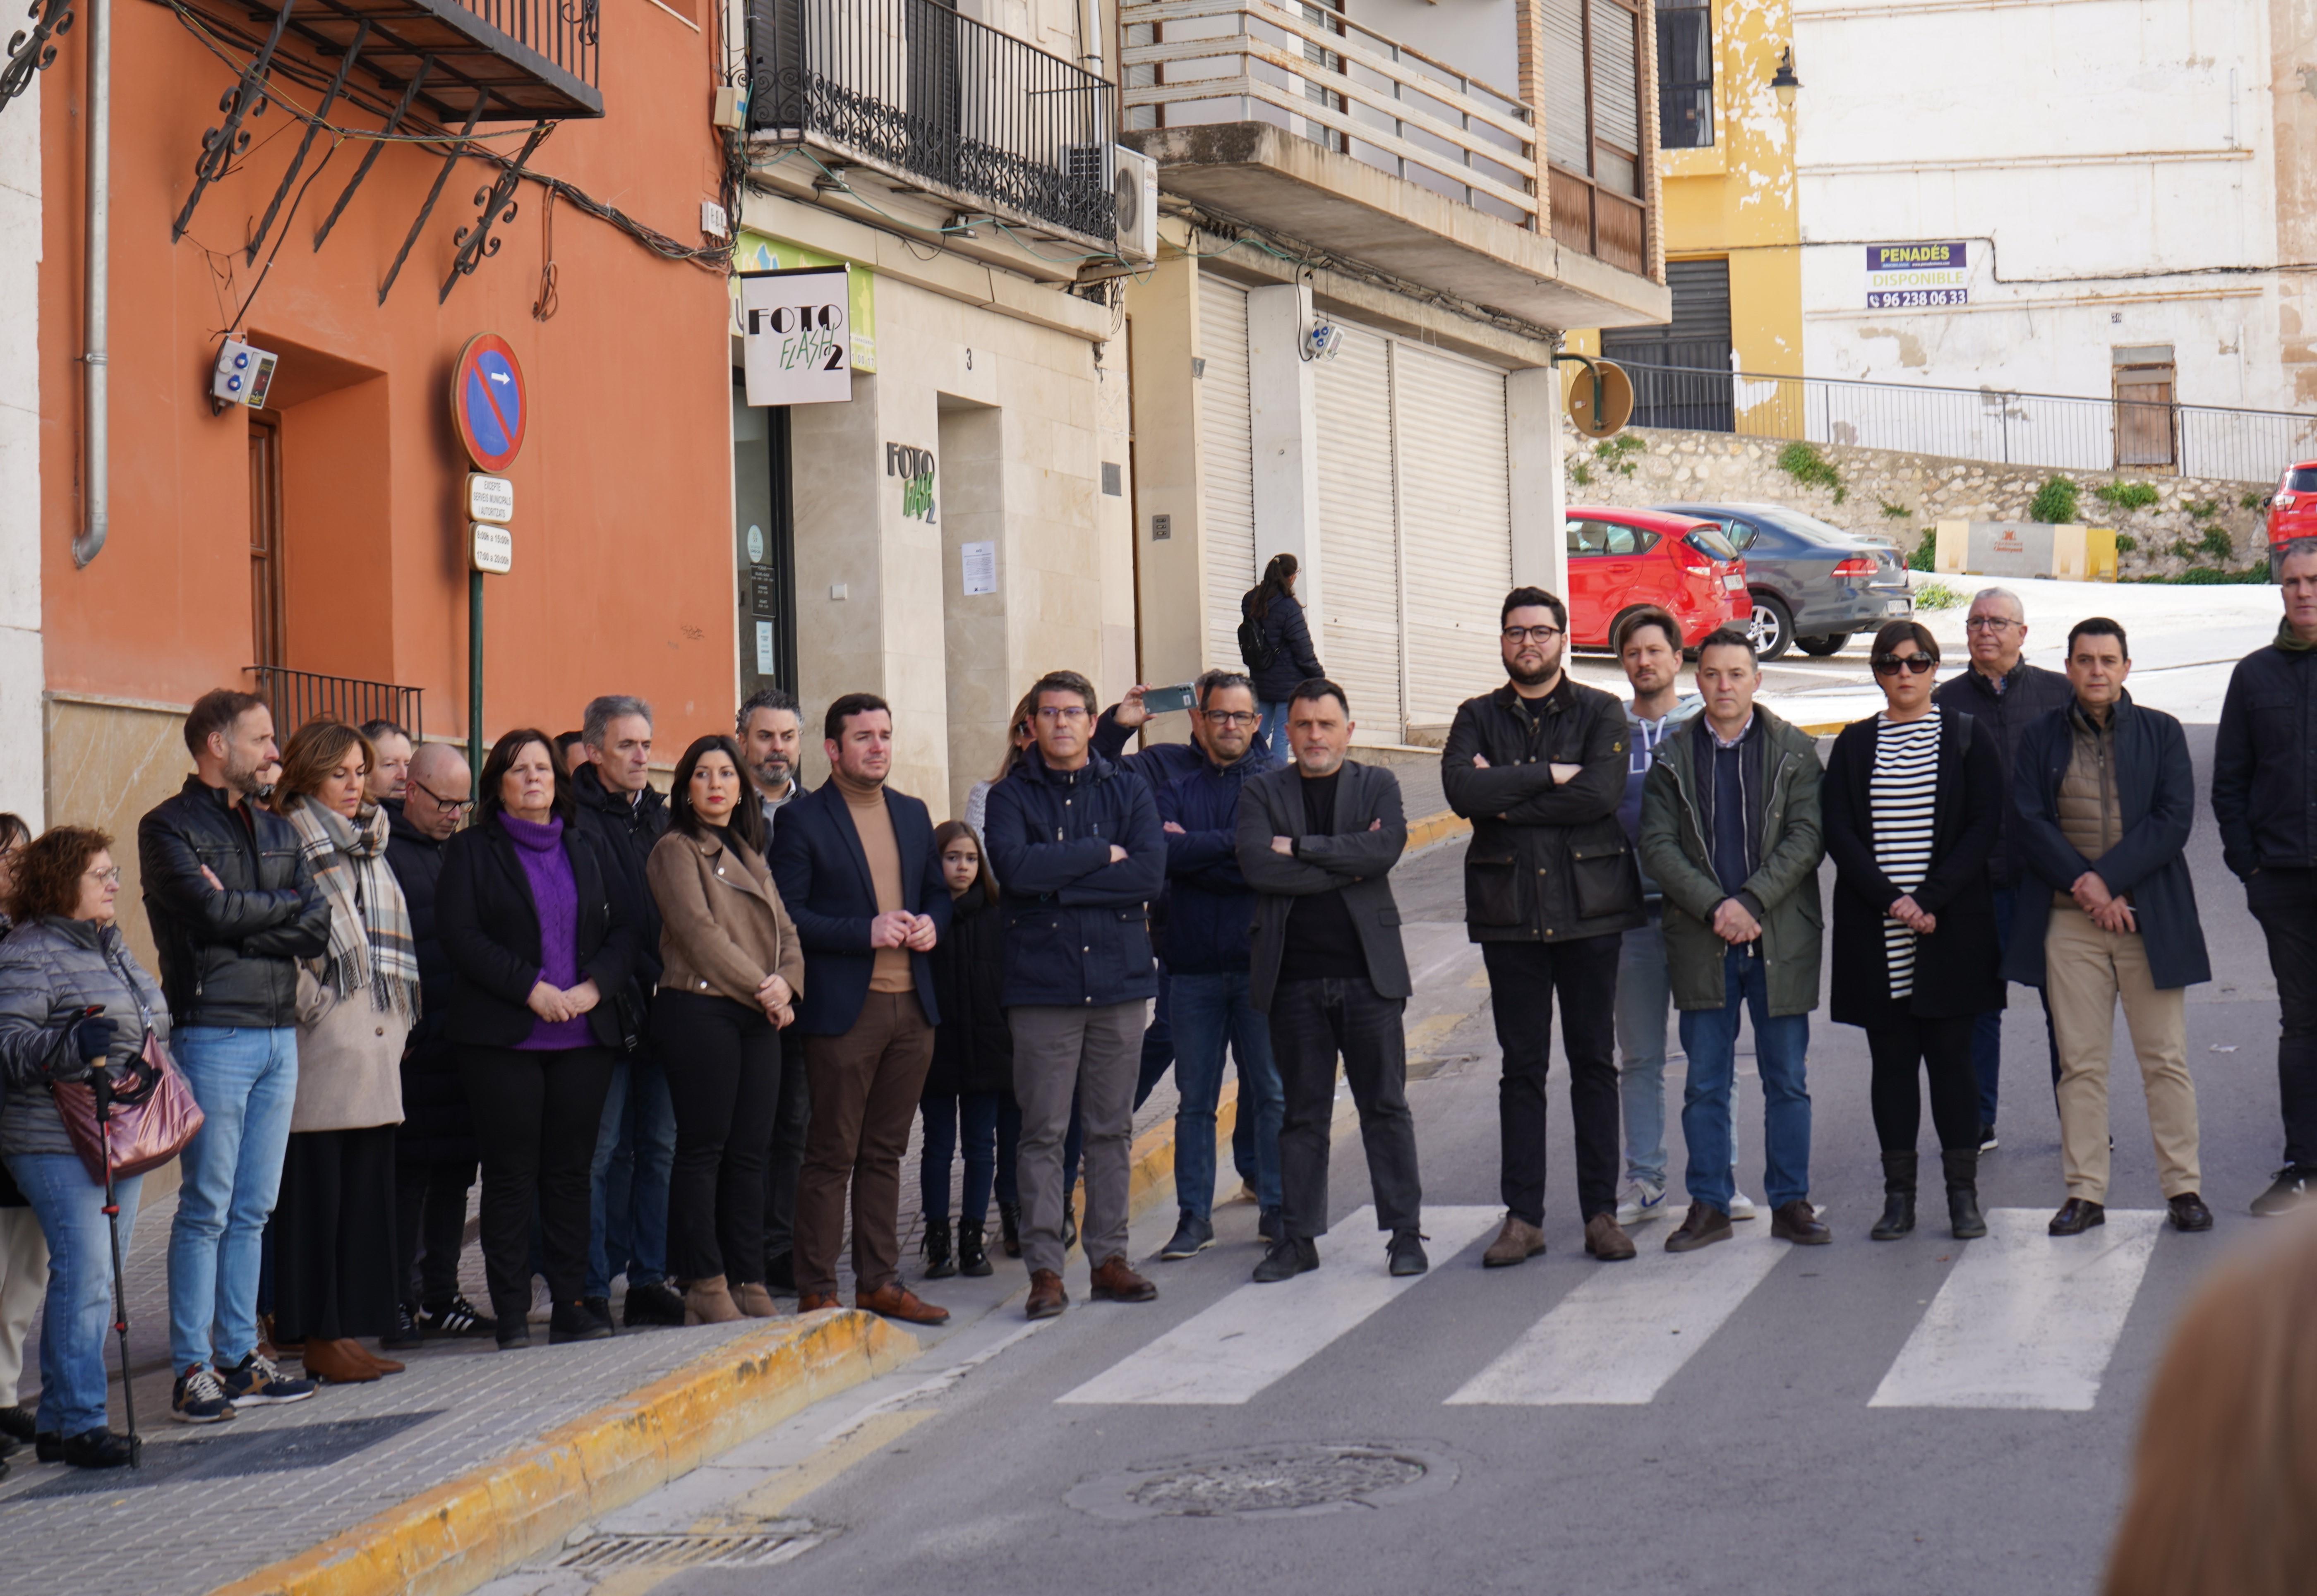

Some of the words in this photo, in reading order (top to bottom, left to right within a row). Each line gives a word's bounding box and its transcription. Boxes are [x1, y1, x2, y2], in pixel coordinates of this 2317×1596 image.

[1881, 244, 1950, 262] PENADÉS
[1873, 271, 1963, 286] DISPONIBLE
[1883, 292, 1900, 307] 96
[1903, 291, 1927, 306] 238
[1930, 290, 1947, 305] 06
[1950, 290, 1965, 304] 33
[748, 304, 842, 335] FOTO
[780, 323, 835, 370] FLASH
[824, 344, 843, 370] 2
[858, 354, 864, 364] 00
[868, 357, 874, 367] 17
[967, 347, 972, 370] 3
[887, 441, 935, 481] FOTO
[485, 481, 501, 491] EXCEPTE
[473, 491, 488, 502] SERVEIS
[489, 494, 511, 506] MUNICIPALS
[481, 506, 505, 518] AUTORITZATS
[926, 498, 936, 524] 2
[477, 530, 489, 541] 8:00h
[494, 534, 509, 545] 15:00h
[477, 551, 489, 561] 17:00
[494, 554, 509, 565] 20:00h
